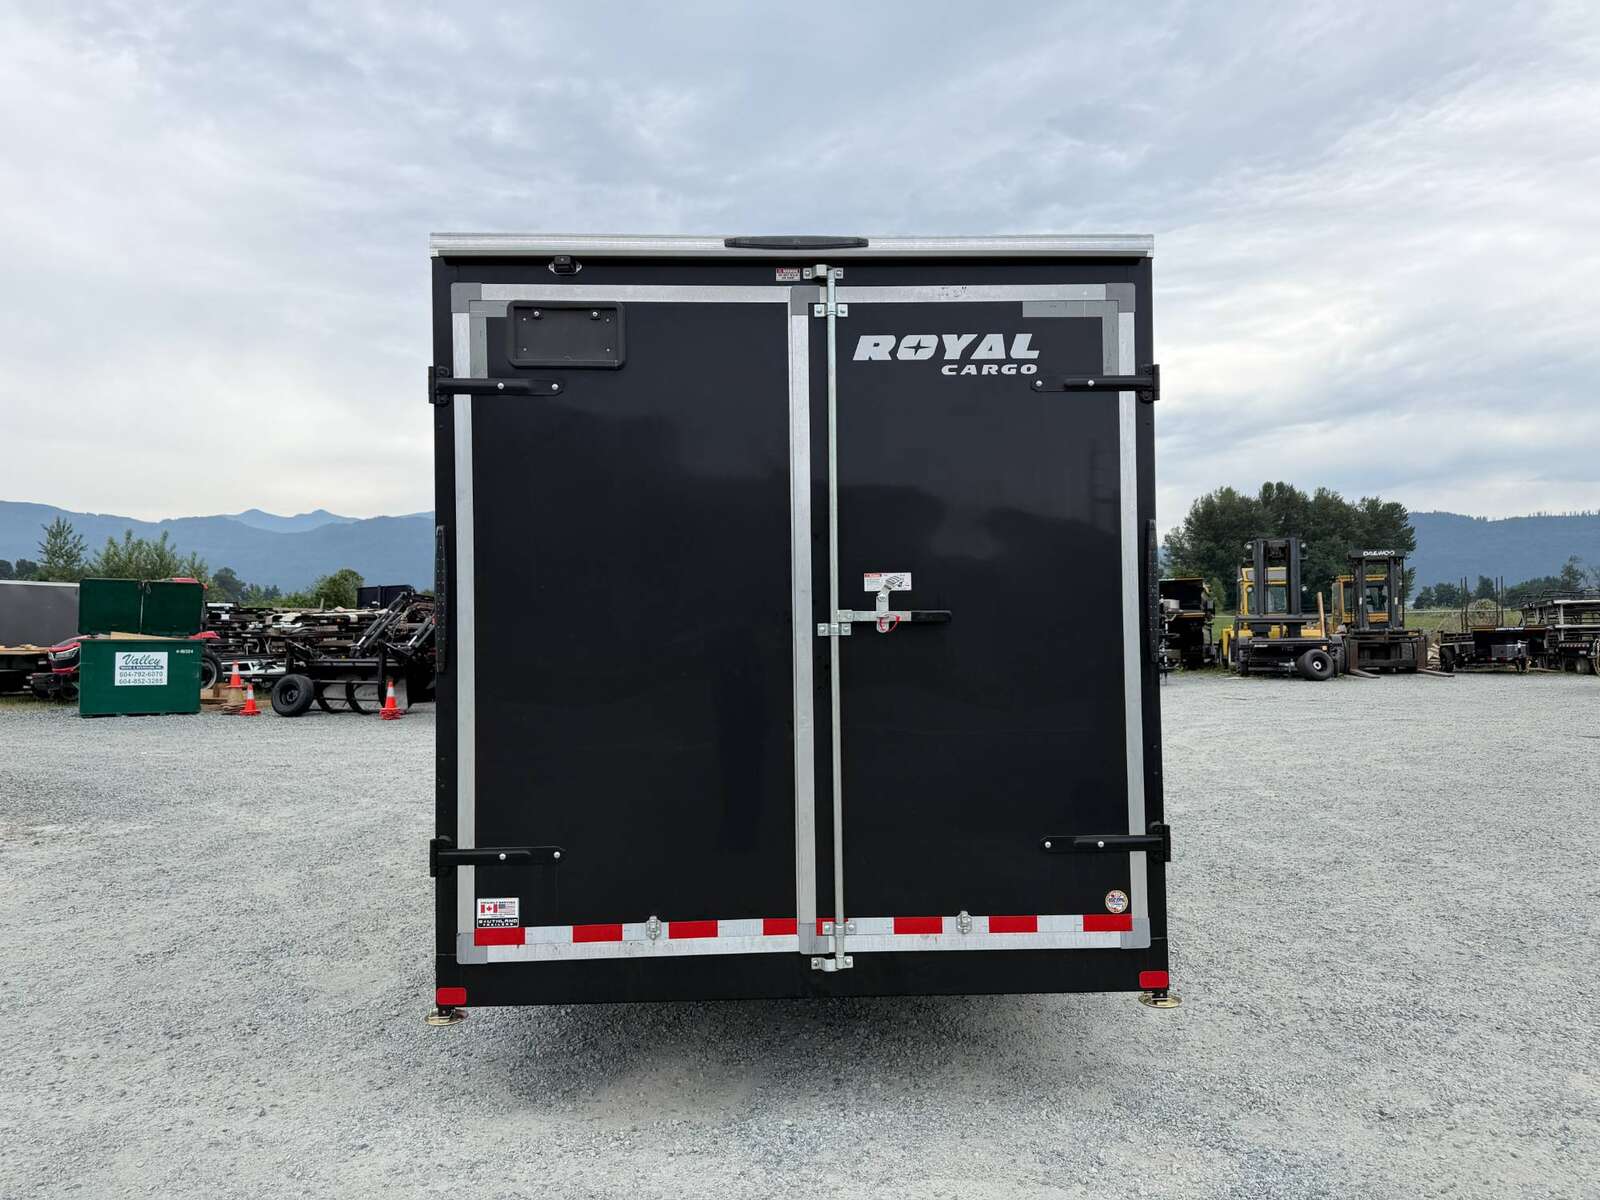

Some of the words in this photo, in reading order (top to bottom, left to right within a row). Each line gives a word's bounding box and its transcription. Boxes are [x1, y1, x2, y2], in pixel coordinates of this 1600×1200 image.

[852, 333, 1040, 361] ROYAL
[941, 363, 1038, 376] CARGO
[122, 654, 161, 666] Valley
